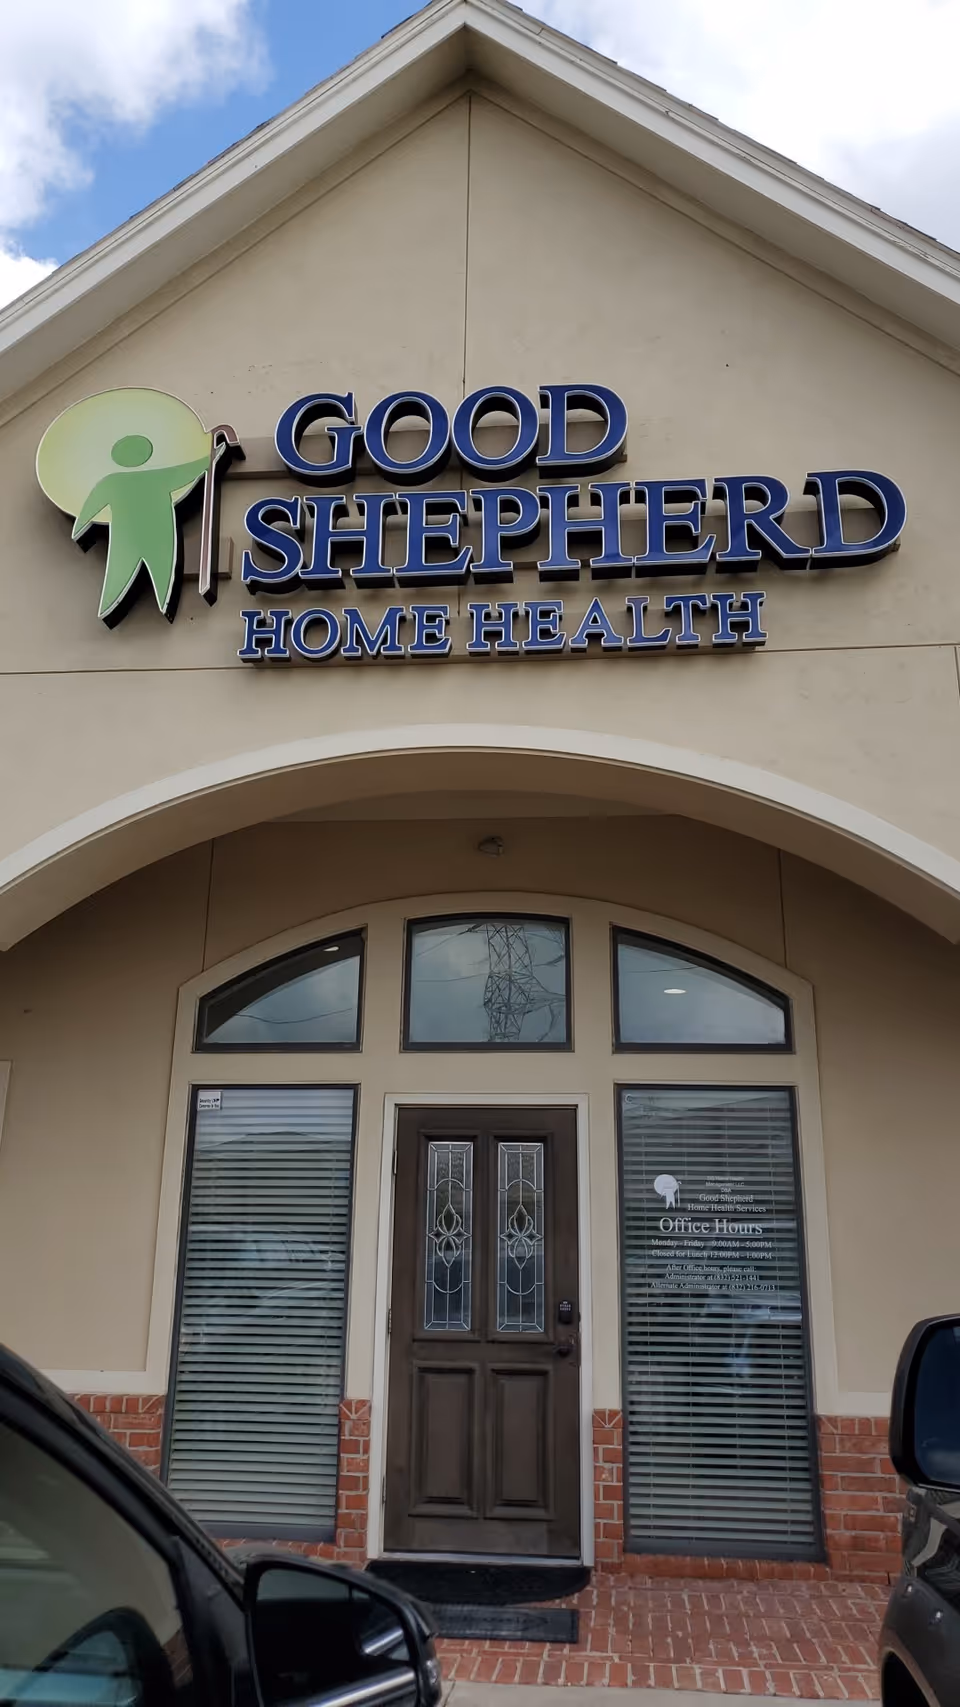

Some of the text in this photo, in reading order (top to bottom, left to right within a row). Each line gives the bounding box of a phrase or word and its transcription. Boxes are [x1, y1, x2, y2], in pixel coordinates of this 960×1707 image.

[274, 383, 629, 480] GOOD
[241, 470, 908, 588] SHEPHERD
[238, 592, 769, 660] HOME HEALTH
[699, 1194, 754, 1204] Good Shepherd
[687, 1203, 767, 1213] Home Health Services
[660, 1217, 763, 1235] Office Hours
[651, 1239, 676, 1248] Monday
[683, 1239, 704, 1248] Friday
[711, 1240, 739, 1248] 9:00AM
[651, 1249, 674, 1257] Closed
[687, 1250, 708, 1258] Lunch
[710, 1251, 739, 1259] 12:00PM
[683, 1264, 703, 1272] Office
[722, 1265, 742, 1273] please
[650, 1281, 678, 1289] Alternate
[679, 1282, 720, 1290] Administrator
